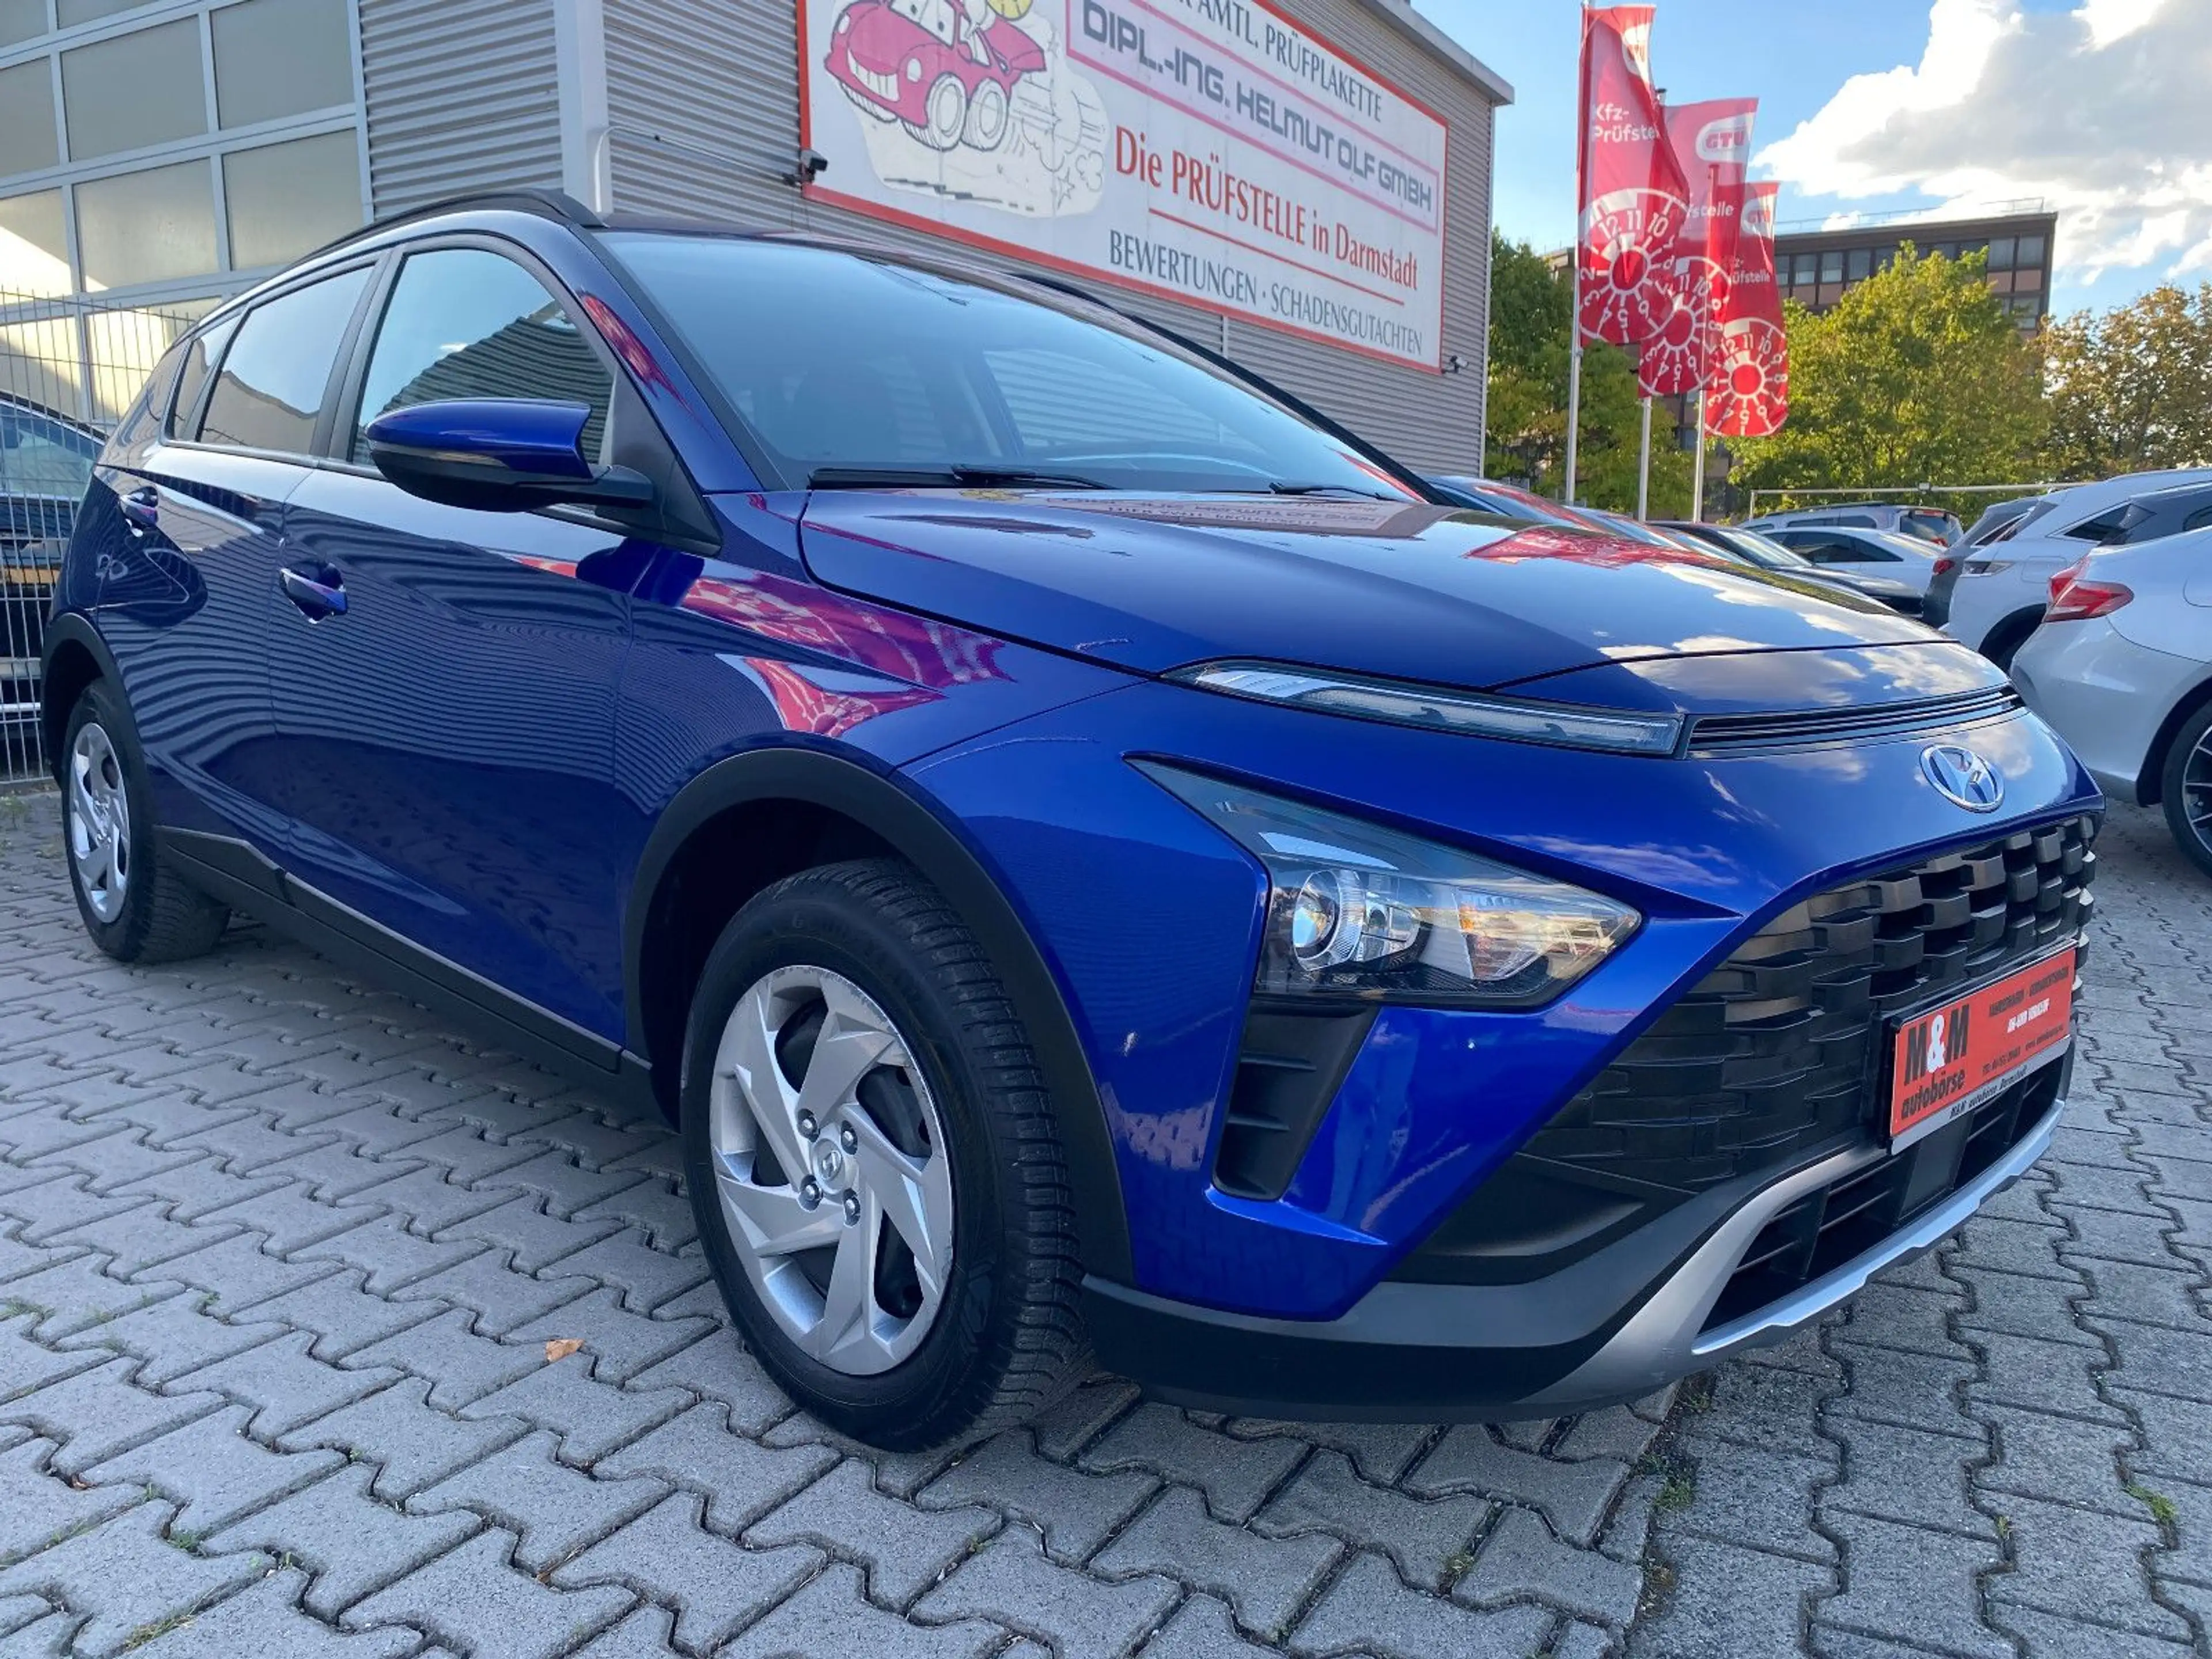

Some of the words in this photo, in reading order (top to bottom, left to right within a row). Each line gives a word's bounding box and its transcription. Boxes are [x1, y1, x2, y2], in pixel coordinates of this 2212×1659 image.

[1083, 0, 1230, 108] DIPL.-ING.
[1237, 81, 1335, 160] HELMUT
[1338, 138, 1375, 180] OLF
[1378, 160, 1431, 212] GMBH
[1198, 0, 1259, 48] AMTL.
[1266, 24, 1381, 123] PRÜFPLAKETTE
[1116, 124, 1162, 188] Die
[1172, 151, 1305, 246] PRÜFSTELLE
[1312, 209, 1329, 255] in
[1335, 222, 1418, 291] Darmstadt
[1647, 212, 1669, 237] 10
[1109, 229, 1257, 305] BEWERTUNGEN
[1271, 283, 1422, 355] SCHADENSGUTACHTEN
[1902, 1069, 1965, 1120] autobörse
[1904, 1004, 1969, 1086] M&M
